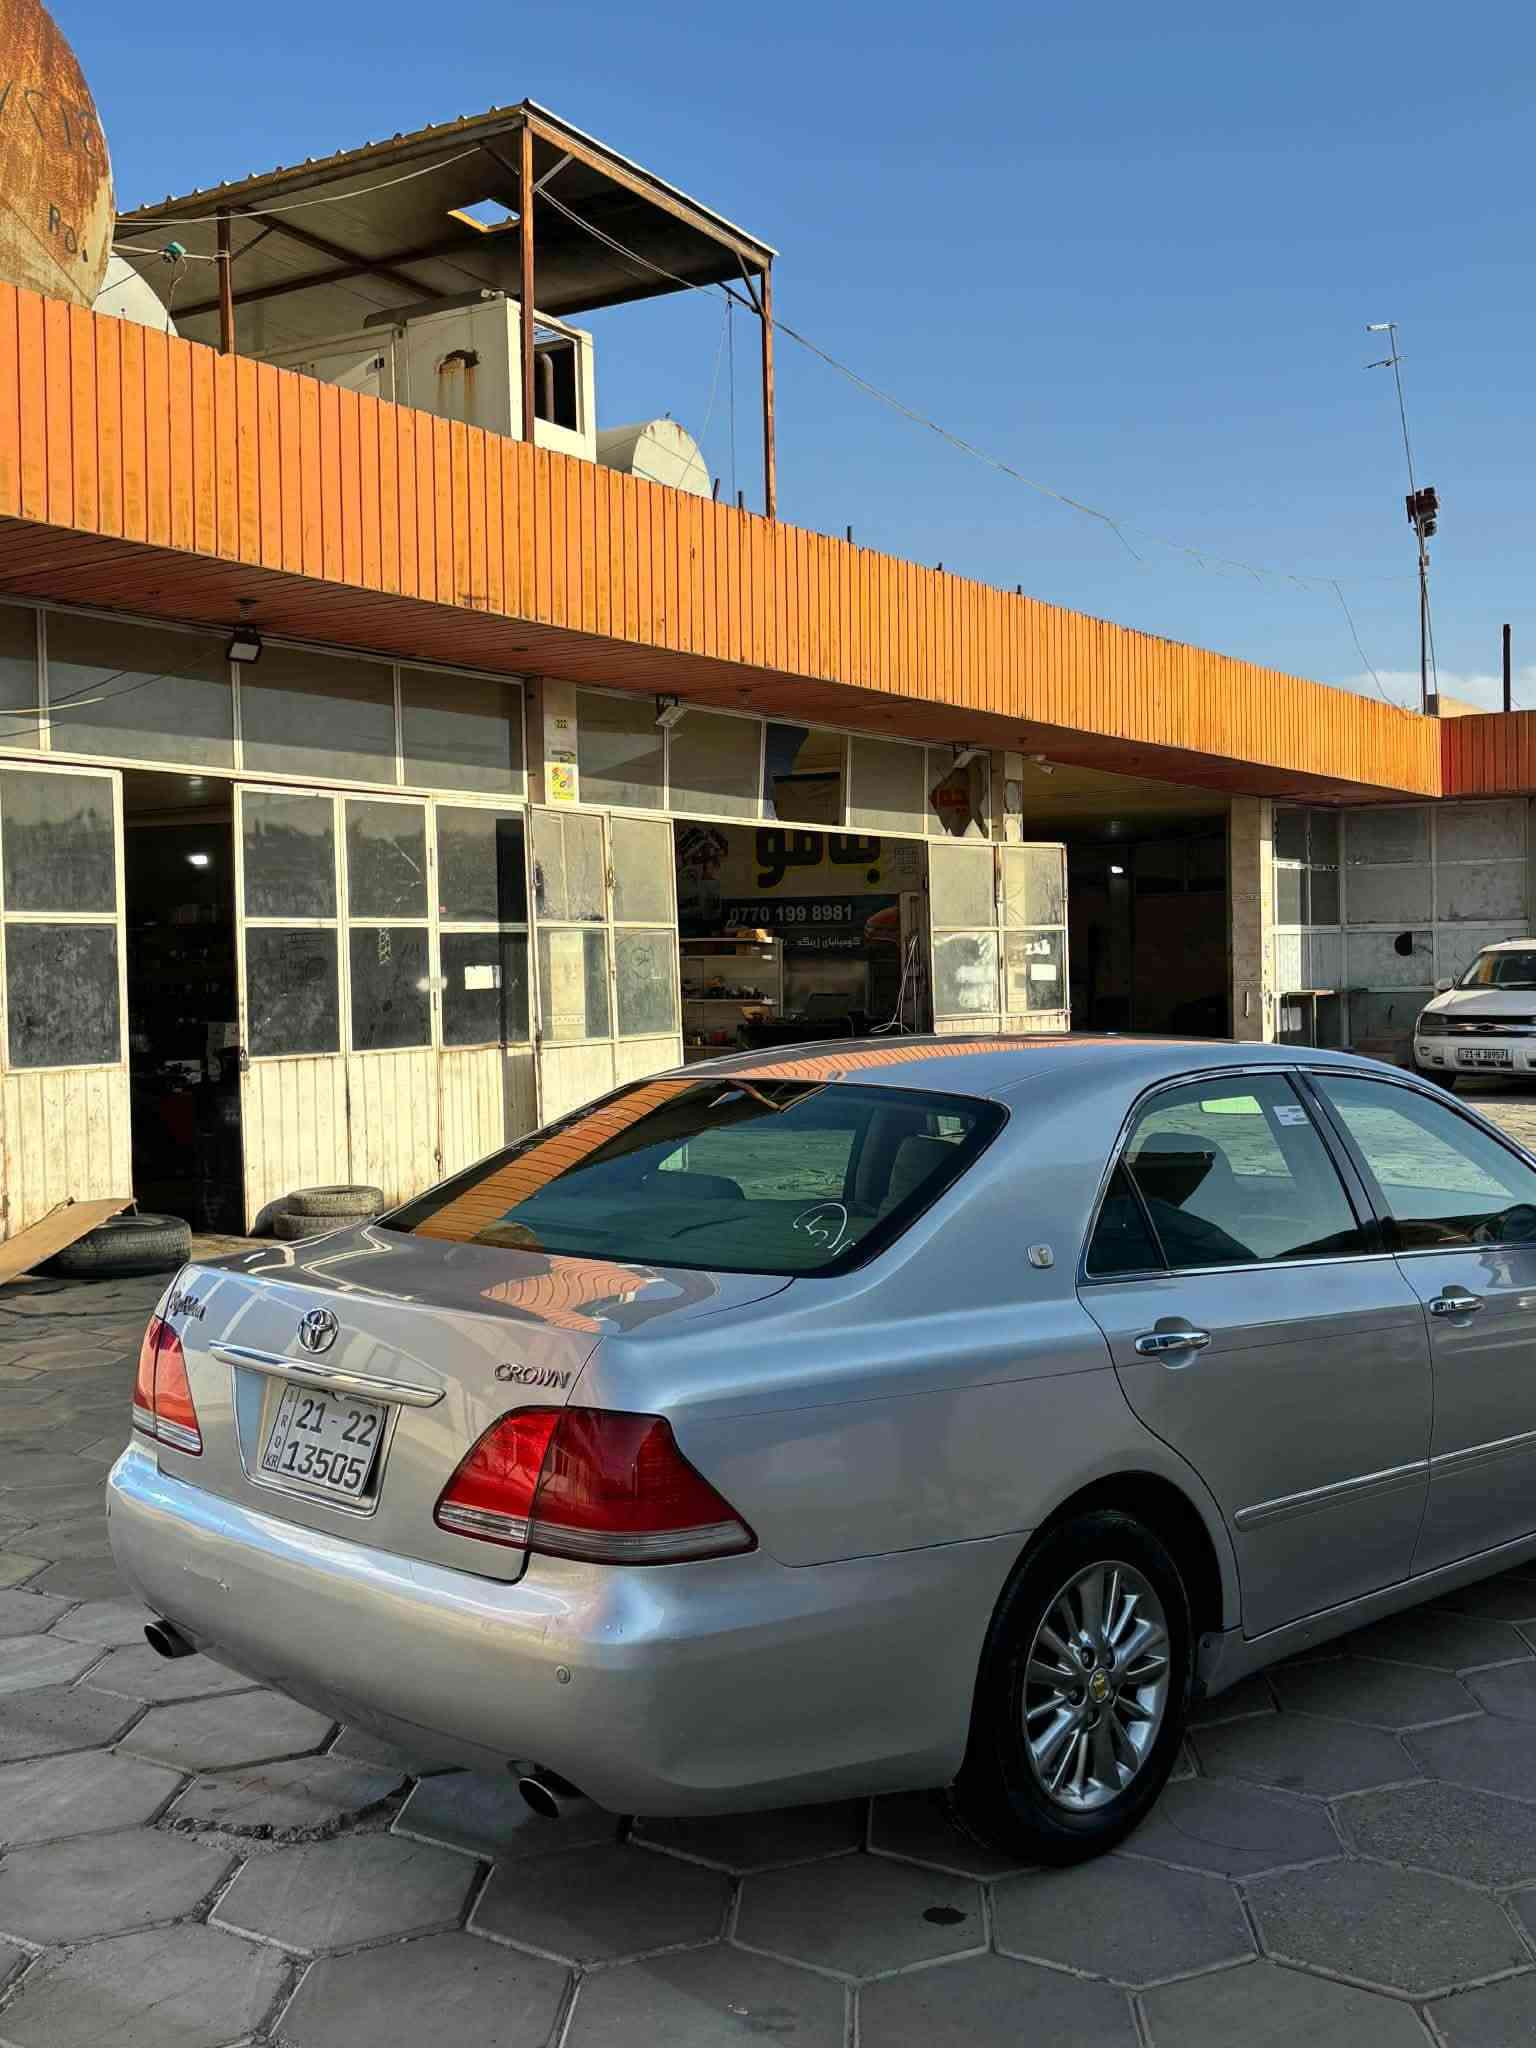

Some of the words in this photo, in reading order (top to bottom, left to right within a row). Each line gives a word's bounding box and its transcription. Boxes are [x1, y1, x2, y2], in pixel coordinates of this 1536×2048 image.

[729, 905, 770, 922] 0770
[776, 904, 807, 922] 199
[812, 903, 853, 921] 8981
[495, 1363, 572, 1389] CROWN
[296, 1398, 327, 1434] 21
[342, 1410, 377, 1447] 22
[282, 1440, 367, 1490] 13505
